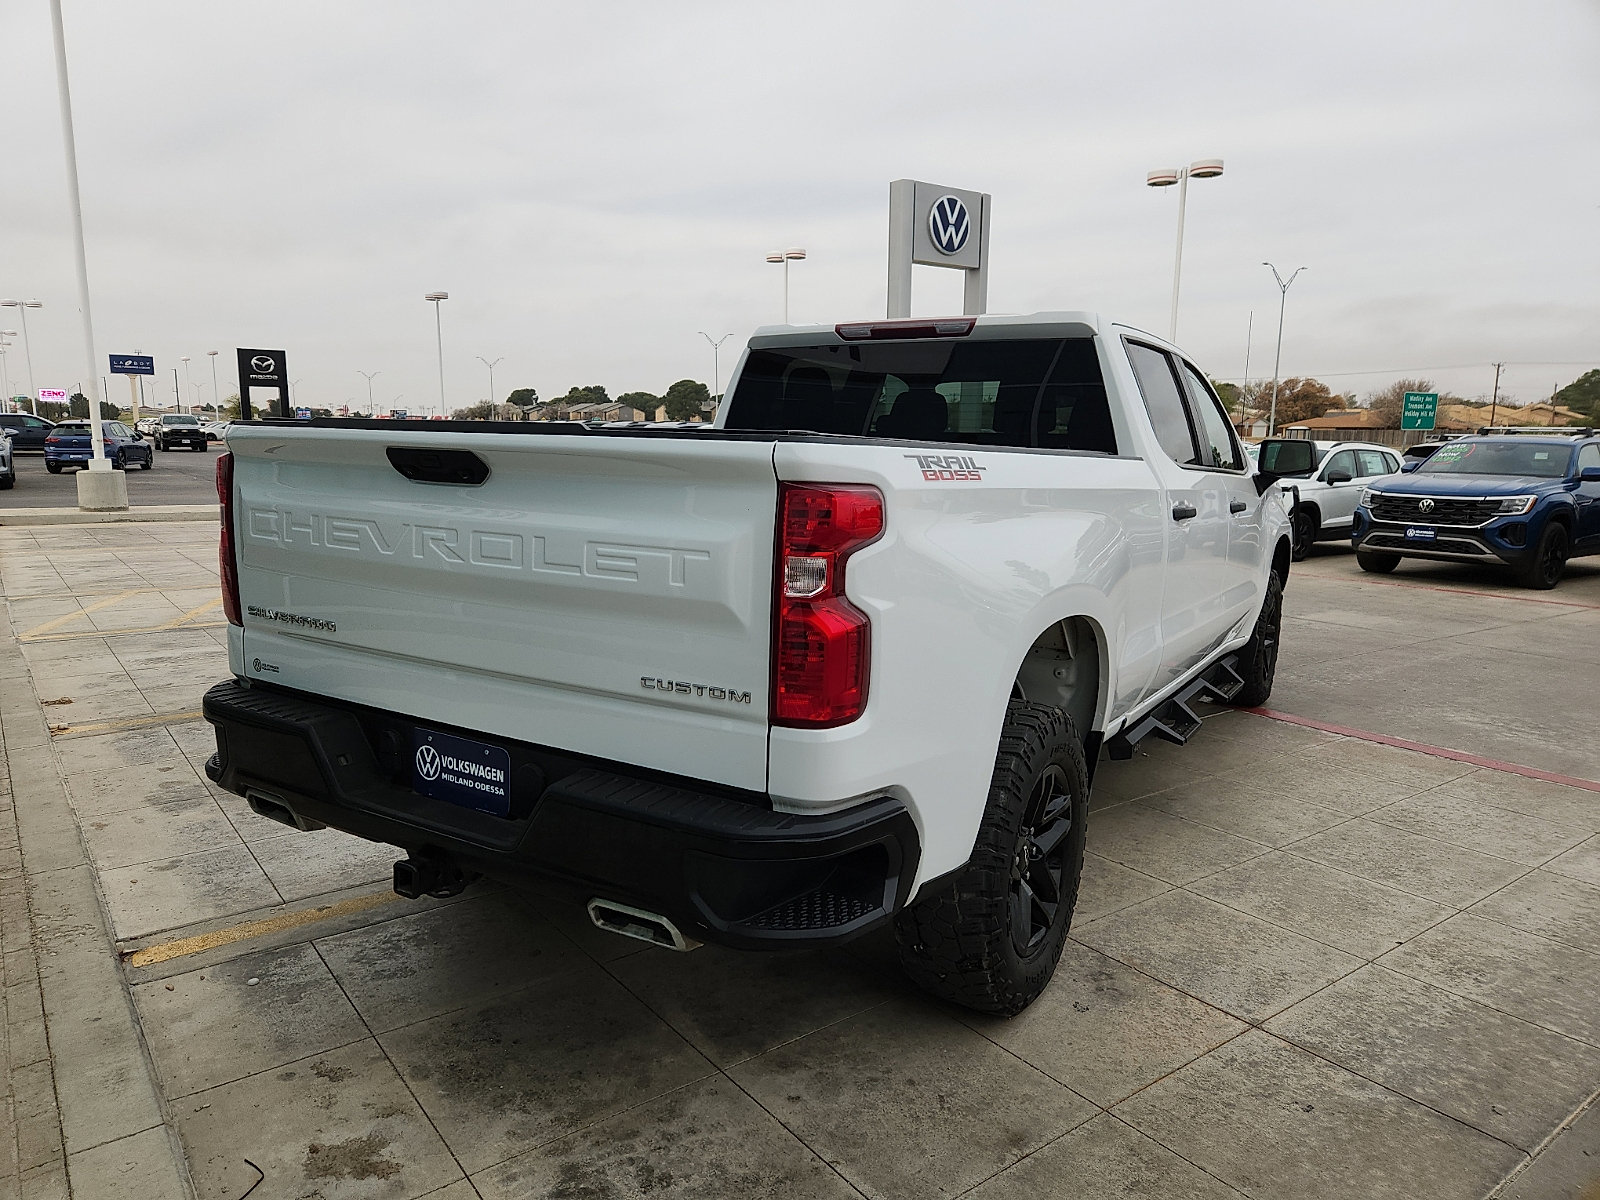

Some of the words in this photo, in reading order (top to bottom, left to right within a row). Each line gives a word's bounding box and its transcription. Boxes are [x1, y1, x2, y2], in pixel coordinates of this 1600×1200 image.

[903, 454, 987, 470] TRAIL
[921, 469, 982, 481] BOSS
[248, 505, 711, 587] CHEVROLET
[247, 605, 337, 633] SILVERADO
[640, 675, 752, 704] CUSTOM
[441, 754, 504, 783] VOLKSWAGEN
[441, 772, 474, 788] MIDLAND
[474, 781, 505, 796] ODESSA
